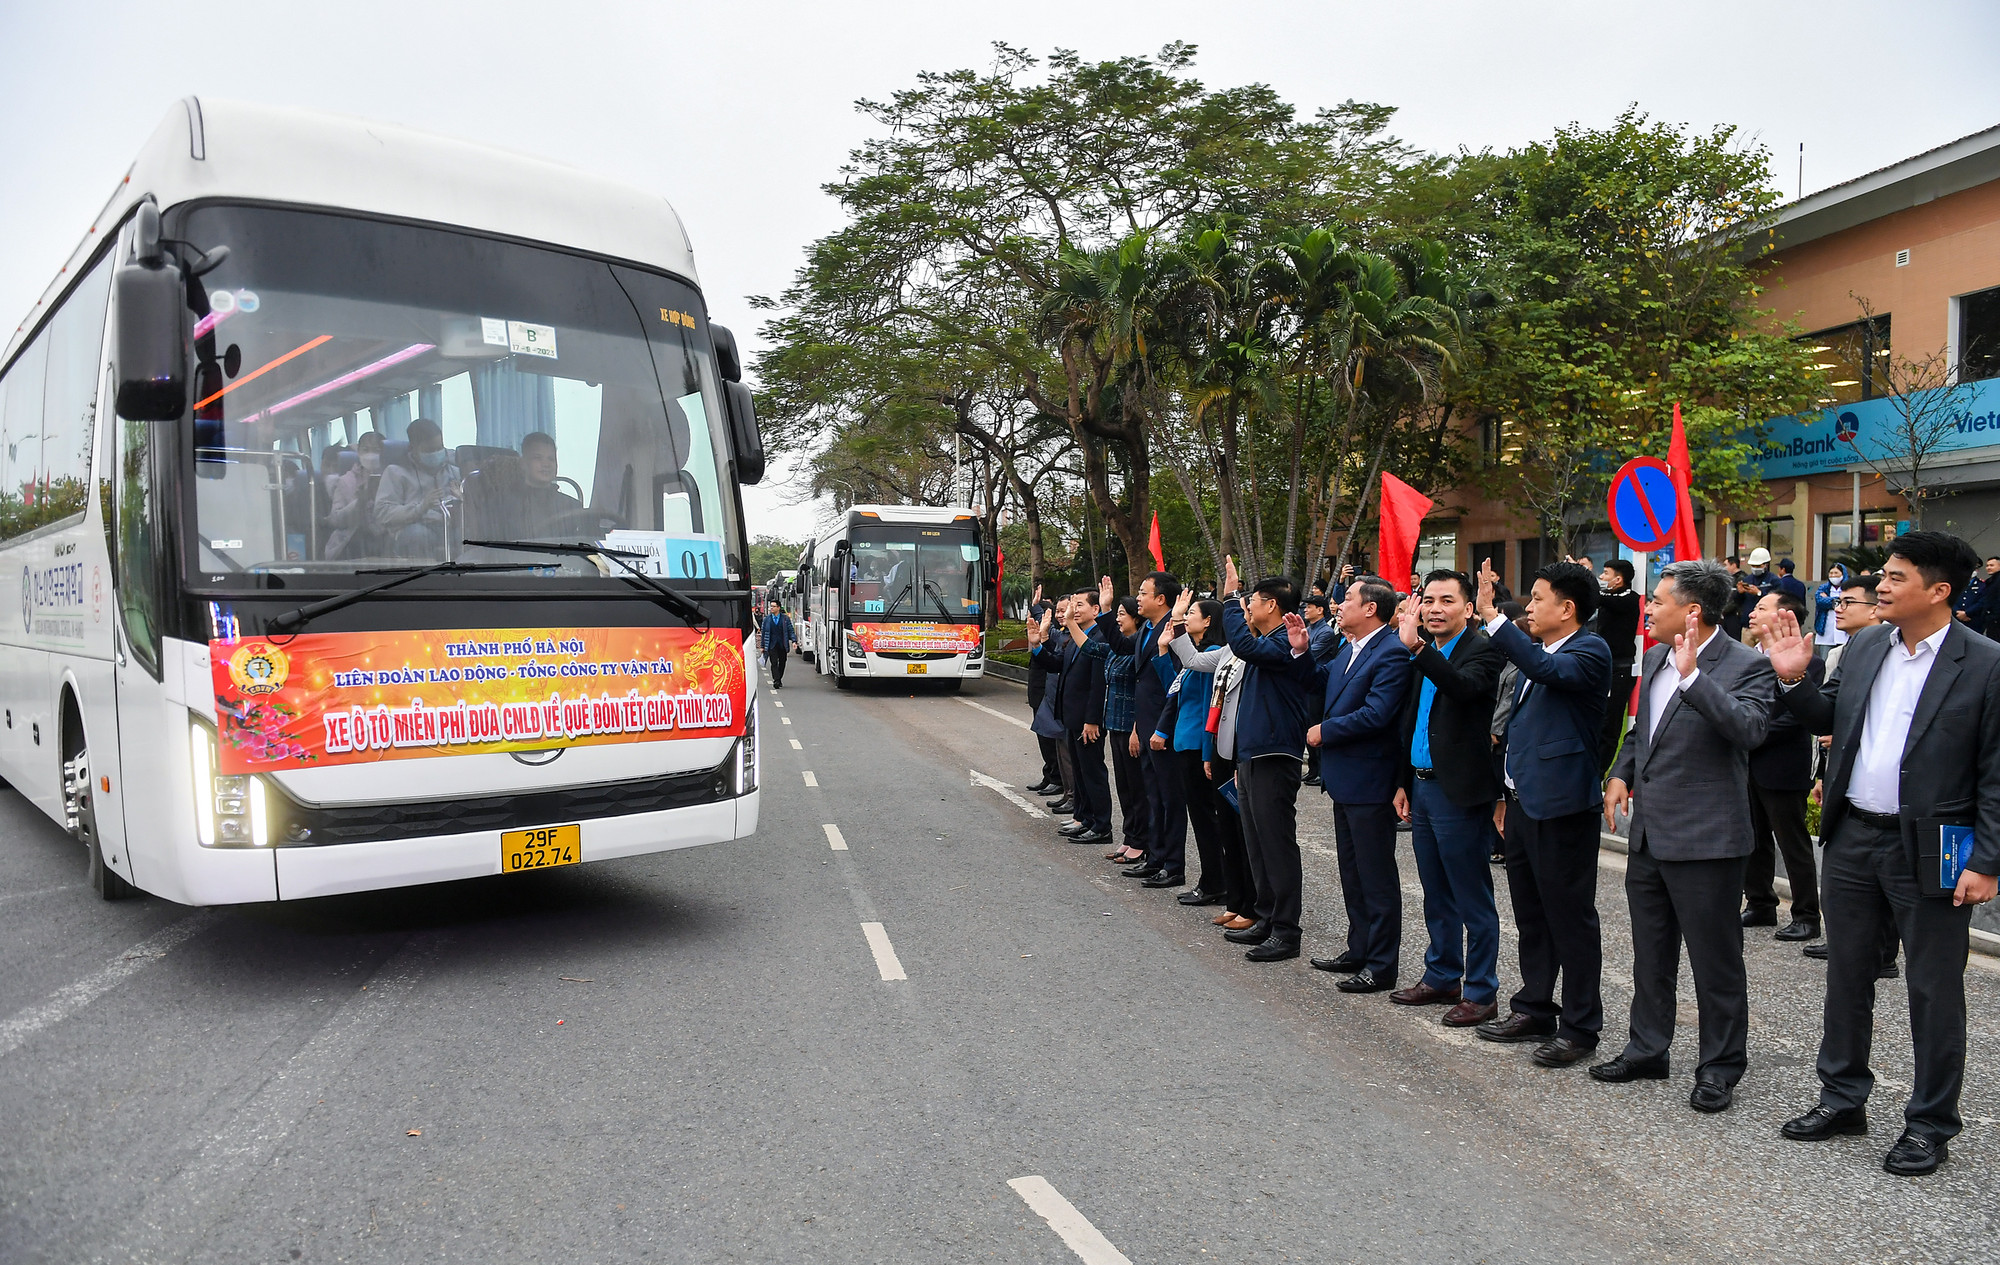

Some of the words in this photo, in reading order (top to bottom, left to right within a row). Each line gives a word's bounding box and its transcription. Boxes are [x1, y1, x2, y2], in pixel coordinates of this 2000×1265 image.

[660, 307, 669, 322] XE
[527, 329, 537, 342] B
[620, 560, 648, 575] XE
[655, 561, 662, 574] 1
[681, 550, 712, 579] 01
[870, 603, 880, 612] 16
[446, 641, 498, 657] THÀNH
[504, 638, 532, 655] PHỐ
[536, 639, 556, 654] HÀ
[559, 638, 584, 655] NỘI
[335, 667, 374, 687] LIÊN
[378, 666, 425, 685] ĐOÀN
[429, 667, 461, 682] LAO
[464, 664, 507, 683] ĐỘNG
[517, 660, 556, 679] TỔNG
[560, 661, 597, 677] CÔNG
[600, 662, 618, 675] TY
[620, 657, 649, 678] VẬN
[651, 656, 672, 674] TẢI
[327, 716, 348, 748] XE
[354, 706, 365, 745] Ô
[369, 706, 389, 744] TÔ
[395, 701, 434, 742] MIỄN
[440, 704, 466, 739] PHÍ
[469, 704, 500, 737] ĐƯA
[503, 705, 539, 735] CNLĐ
[543, 696, 561, 733] VỀ
[565, 698, 590, 734] QUÊ
[593, 694, 619, 730] ĐÓN
[623, 692, 643, 728] TẾT
[647, 694, 674, 726] GIÁP
[677, 690, 703, 724] THÌN
[705, 697, 730, 723] 2024
[525, 829, 557, 849] 29F
[511, 846, 572, 869] 022.74
